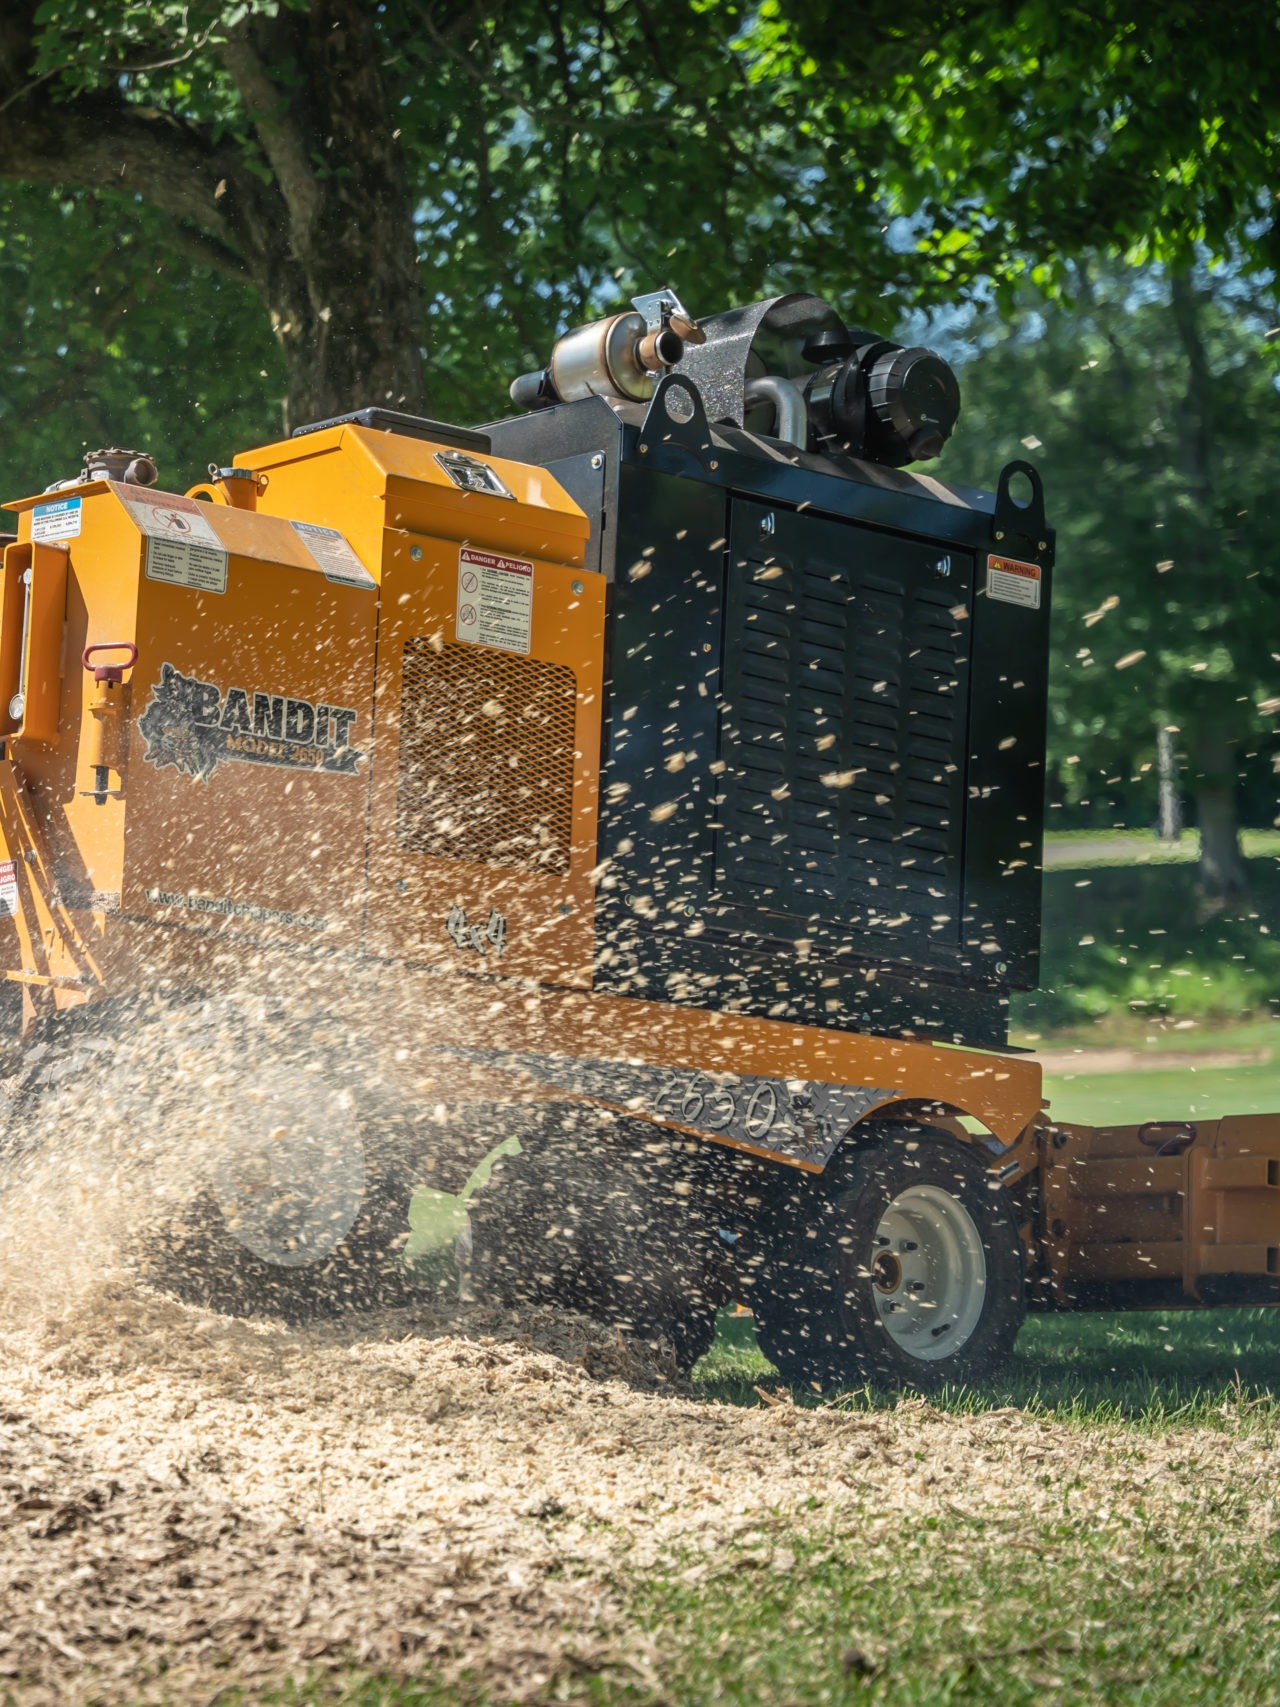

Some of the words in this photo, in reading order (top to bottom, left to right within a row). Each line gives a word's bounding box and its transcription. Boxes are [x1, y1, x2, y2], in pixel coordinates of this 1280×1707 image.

[46, 501, 68, 512] NOTICE
[296, 523, 337, 537] NOTICE
[471, 554, 496, 565] DANGER
[1003, 562, 1036, 577] WARNING
[192, 680, 357, 749] BANDIT
